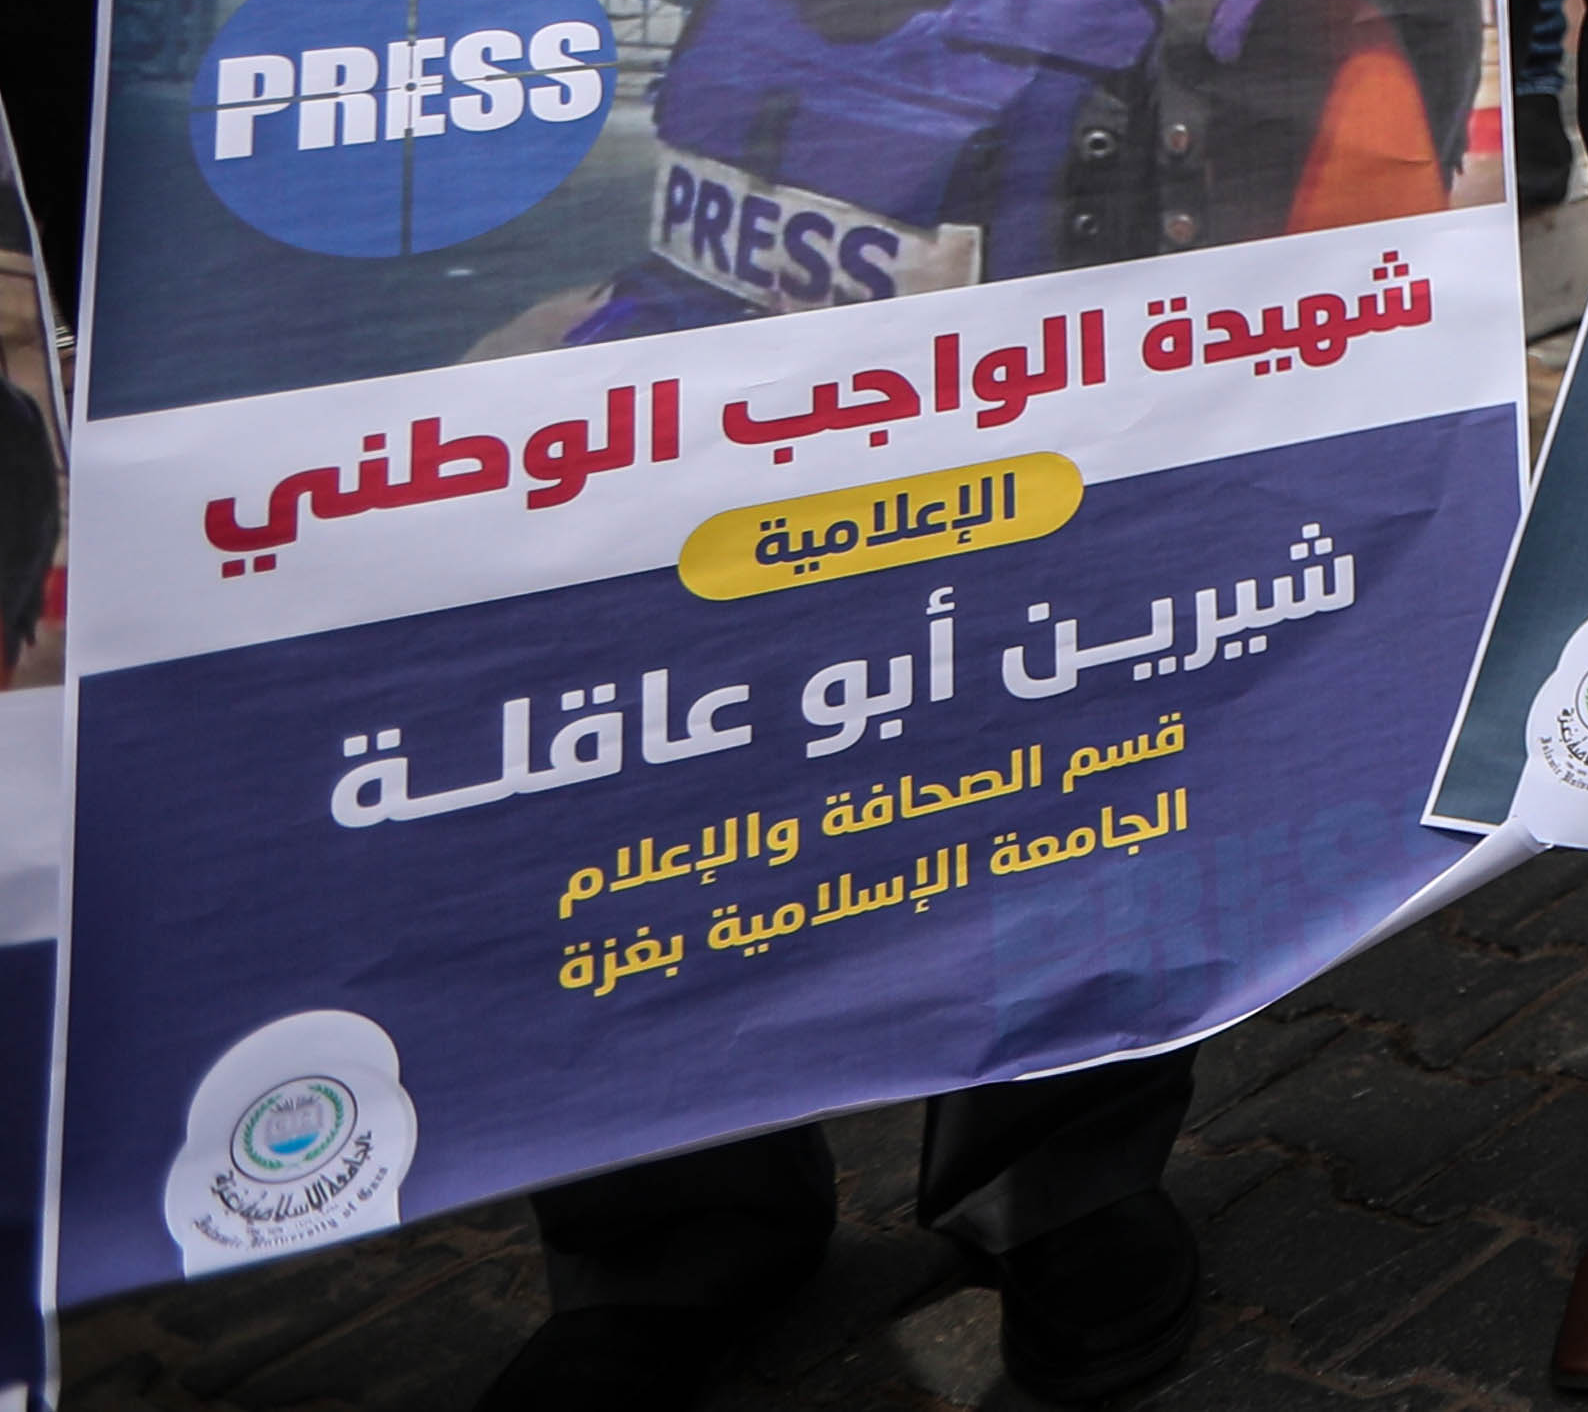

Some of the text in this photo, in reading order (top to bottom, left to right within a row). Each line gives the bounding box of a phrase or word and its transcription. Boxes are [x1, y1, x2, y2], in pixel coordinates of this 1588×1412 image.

[215, 21, 601, 161] PRESS
[662, 175, 902, 308] PRESS
[205, 251, 1431, 577] شهيدة الواجب الوطني
[755, 472, 1015, 575] الإعلامية
[331, 523, 1354, 827] شيرين أبو عاقلة
[558, 713, 1185, 919] قسم الصحافة والإعلام
[558, 788, 1188, 997] الجامعة الإسلامية بغزة
